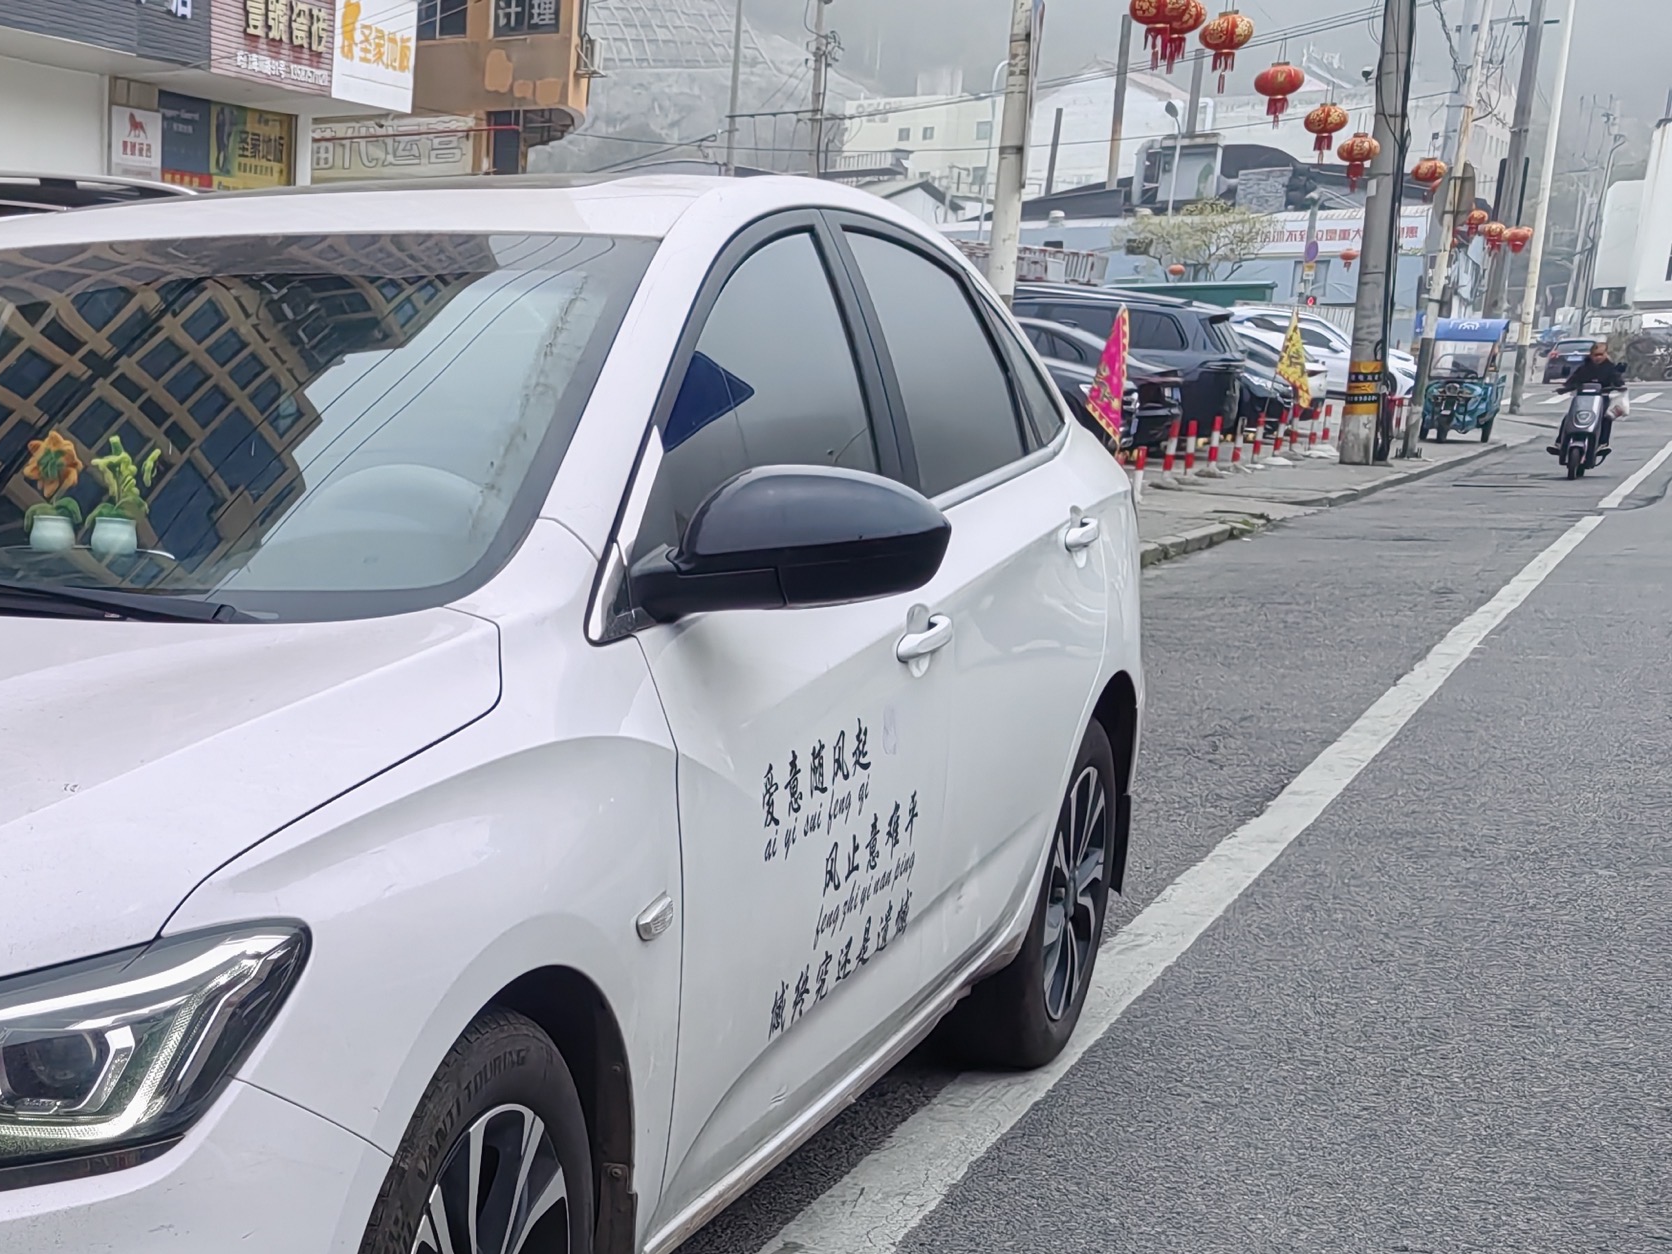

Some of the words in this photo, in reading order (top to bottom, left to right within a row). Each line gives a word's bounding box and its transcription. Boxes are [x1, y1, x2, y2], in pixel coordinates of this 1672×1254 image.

[762, 718, 872, 829] 爱意随风起
[822, 789, 919, 898] 风止意难平
